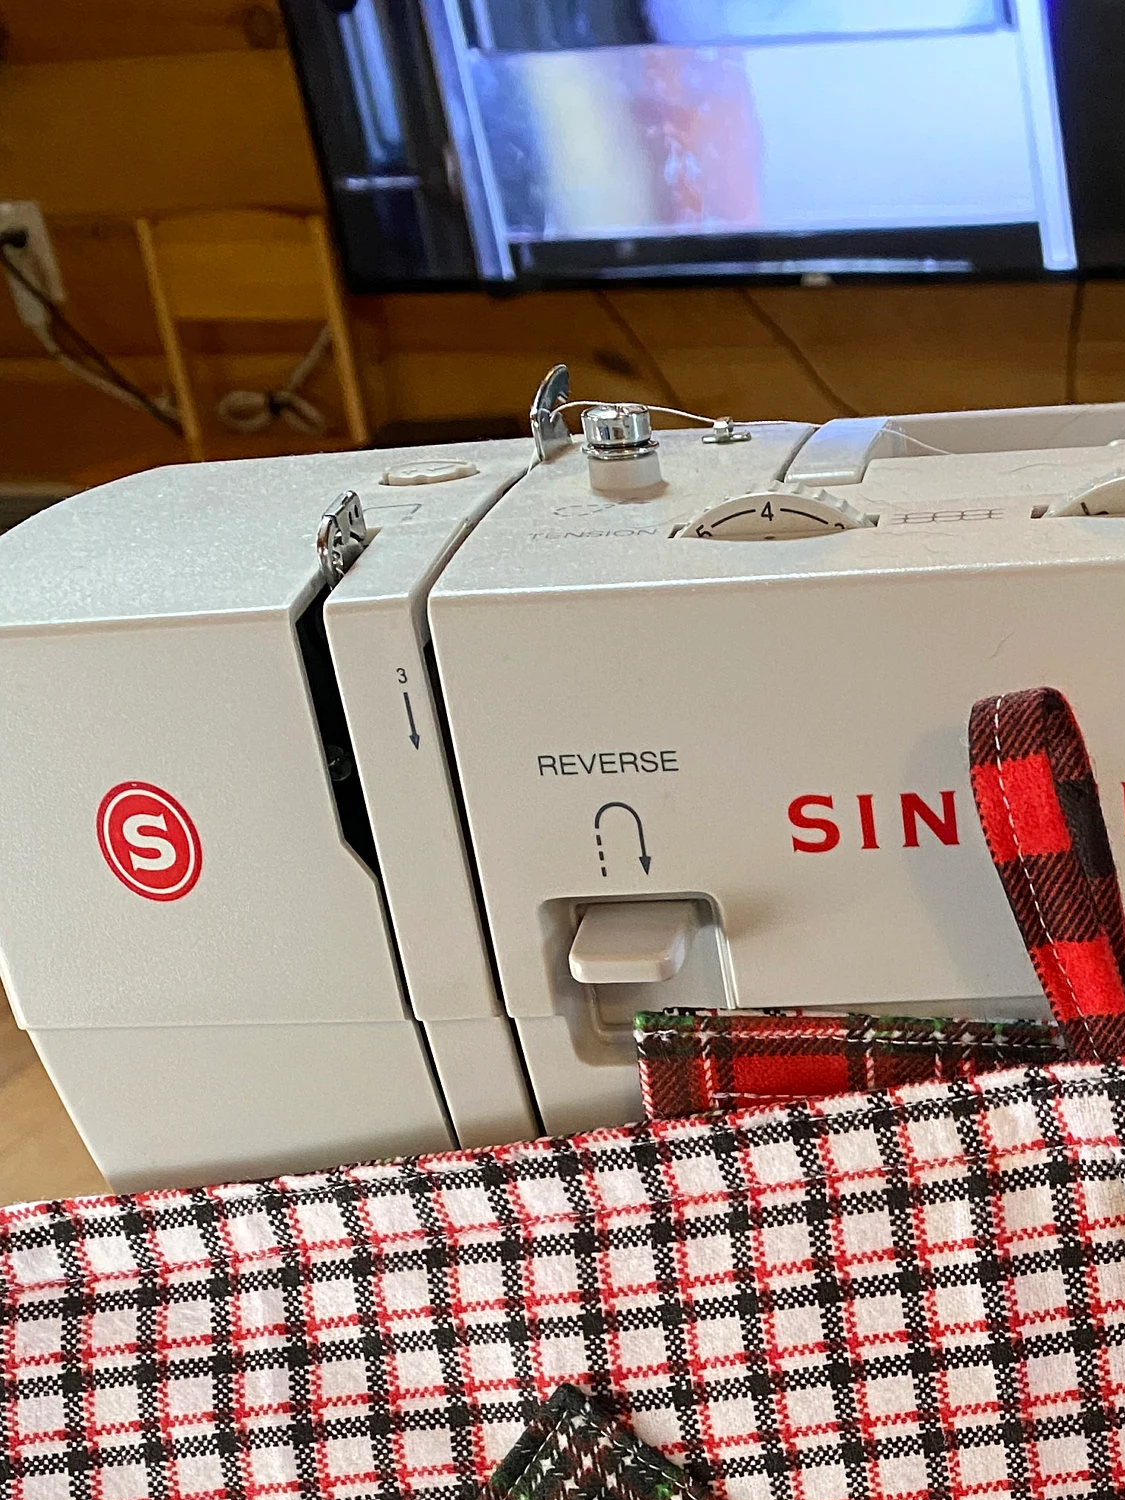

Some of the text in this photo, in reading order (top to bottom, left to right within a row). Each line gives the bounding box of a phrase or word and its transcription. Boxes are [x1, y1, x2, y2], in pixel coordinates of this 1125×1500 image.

[760, 500, 774, 522] 4
[529, 527, 658, 541] TENSION
[395, 667, 408, 684] 3
[537, 750, 680, 776] REVERSE
[122, 813, 177, 871] S
